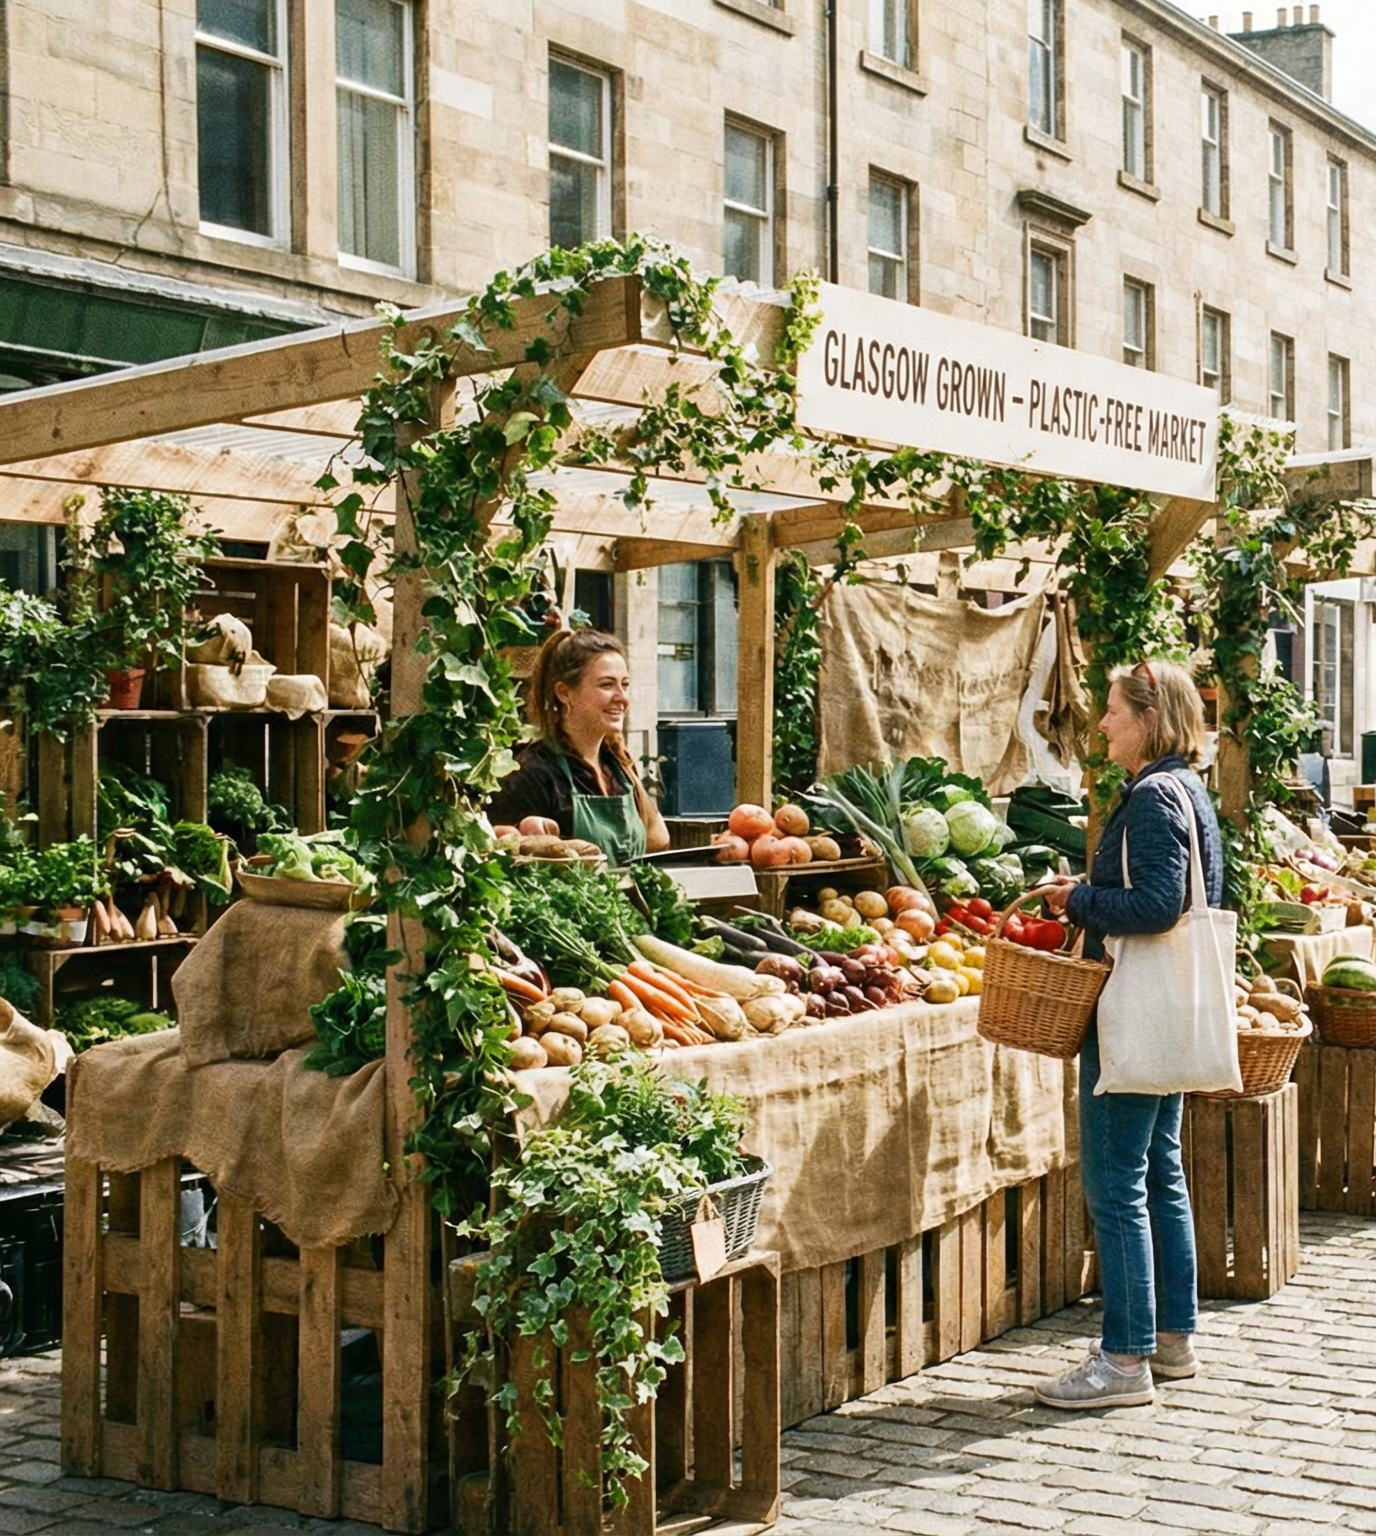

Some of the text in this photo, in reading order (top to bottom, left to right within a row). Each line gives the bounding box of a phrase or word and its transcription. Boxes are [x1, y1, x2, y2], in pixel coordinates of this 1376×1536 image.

[823, 329, 929, 406] GLASGOW
[936, 357, 1006, 422] GROWN
[1029, 379, 1142, 452] PLASTIC-FREE
[1147, 410, 1206, 465] MARKET
